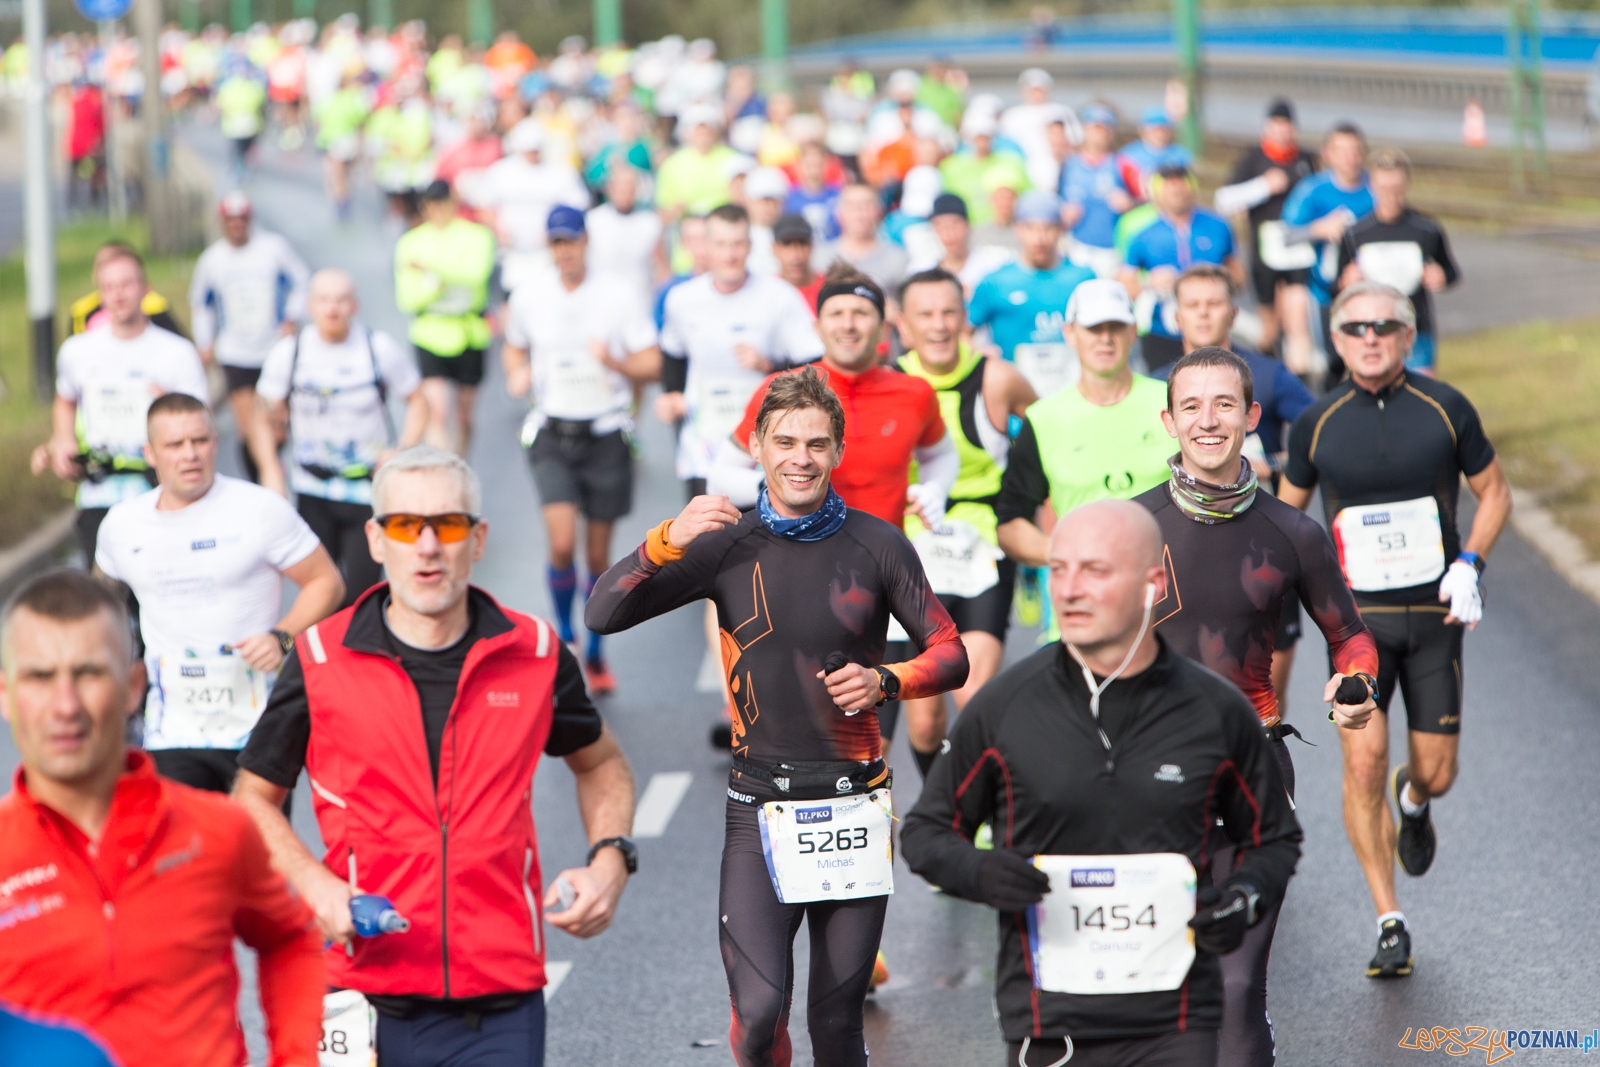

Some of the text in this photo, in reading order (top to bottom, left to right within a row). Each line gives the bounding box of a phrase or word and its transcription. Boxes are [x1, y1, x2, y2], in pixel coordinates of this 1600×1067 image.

[1378, 532, 1407, 551] 53
[185, 686, 235, 707] 2471
[798, 810, 830, 820] 17.PKO
[797, 827, 868, 854] 5263
[817, 856, 855, 869] Michaś
[1070, 904, 1157, 931] 1454
